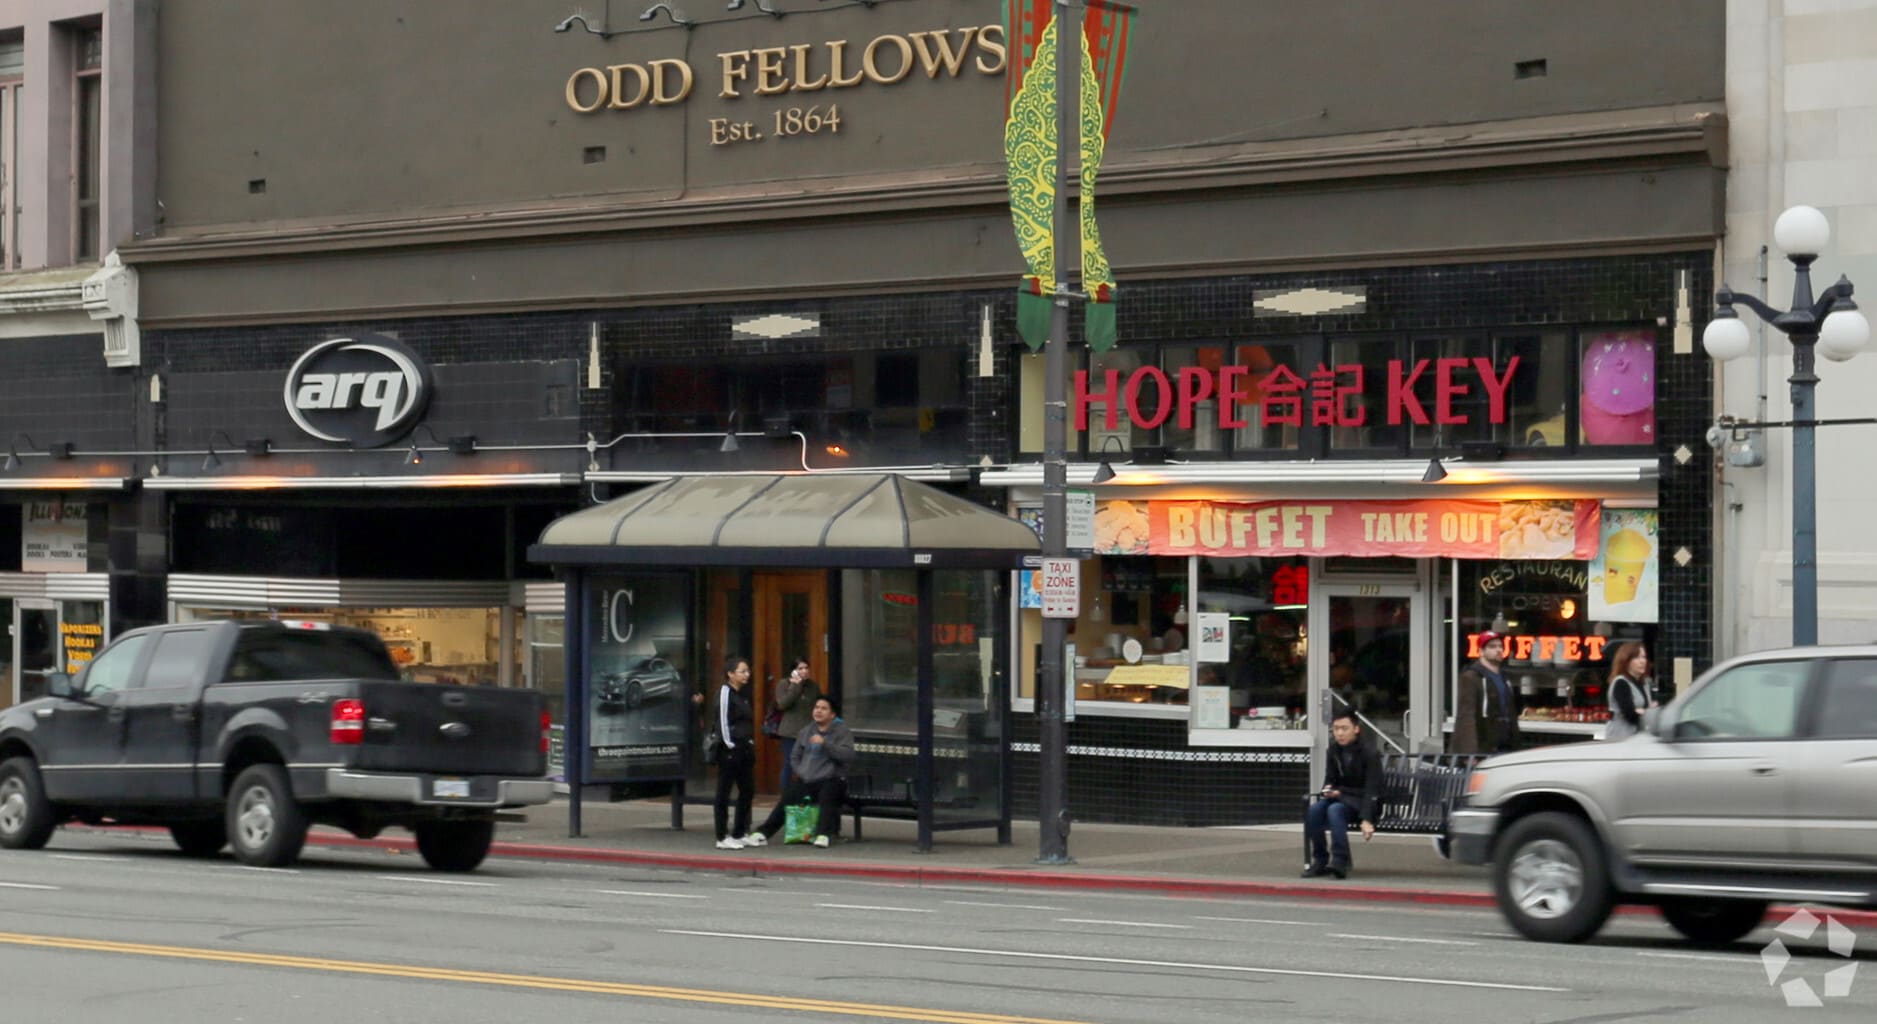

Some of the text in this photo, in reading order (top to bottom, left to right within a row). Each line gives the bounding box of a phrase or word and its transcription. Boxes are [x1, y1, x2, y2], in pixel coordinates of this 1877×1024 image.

[565, 24, 1007, 114] ODD FELLOWS
[709, 104, 840, 146] Est. 1864
[296, 371, 403, 431] arq
[1073, 355, 1520, 431] HOPE 合記 KEY
[1168, 505, 1497, 549] BUFFET TAKE OUT
[1046, 576, 1075, 588] ZONE
[1048, 562, 1072, 573] TAXI
[1480, 559, 1589, 595] RESTAURAN
[610, 589, 633, 643] C
